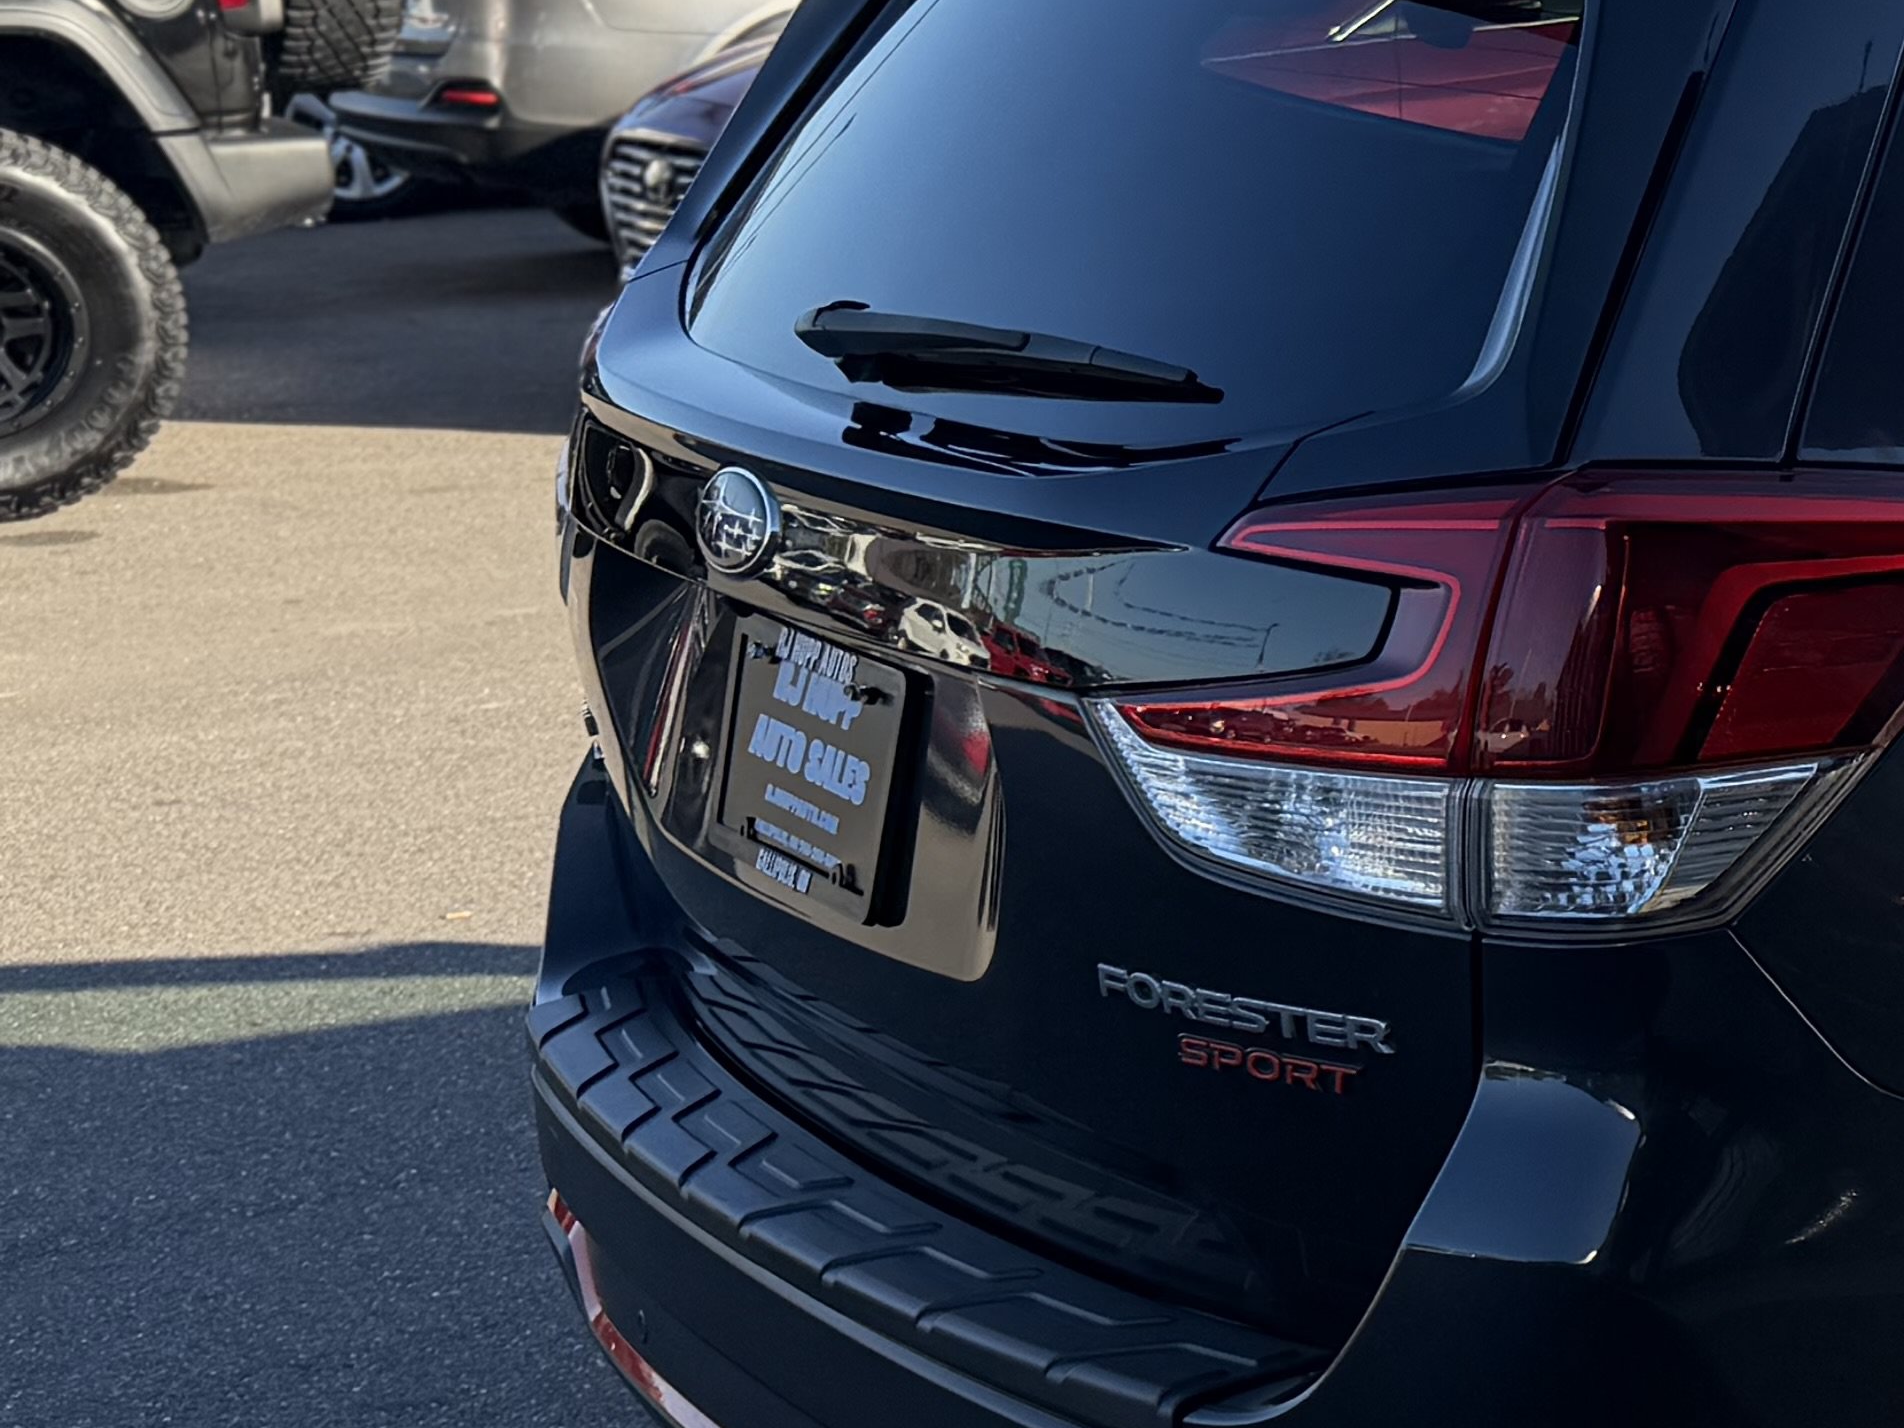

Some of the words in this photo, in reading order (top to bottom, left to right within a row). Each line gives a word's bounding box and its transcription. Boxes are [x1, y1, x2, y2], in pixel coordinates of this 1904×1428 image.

[817, 643, 858, 684] AUTOS
[747, 712, 807, 774] AUTO
[804, 738, 871, 806] SALES
[1097, 962, 1396, 1055] FORESTER
[1178, 1032, 1362, 1096] SPORT
